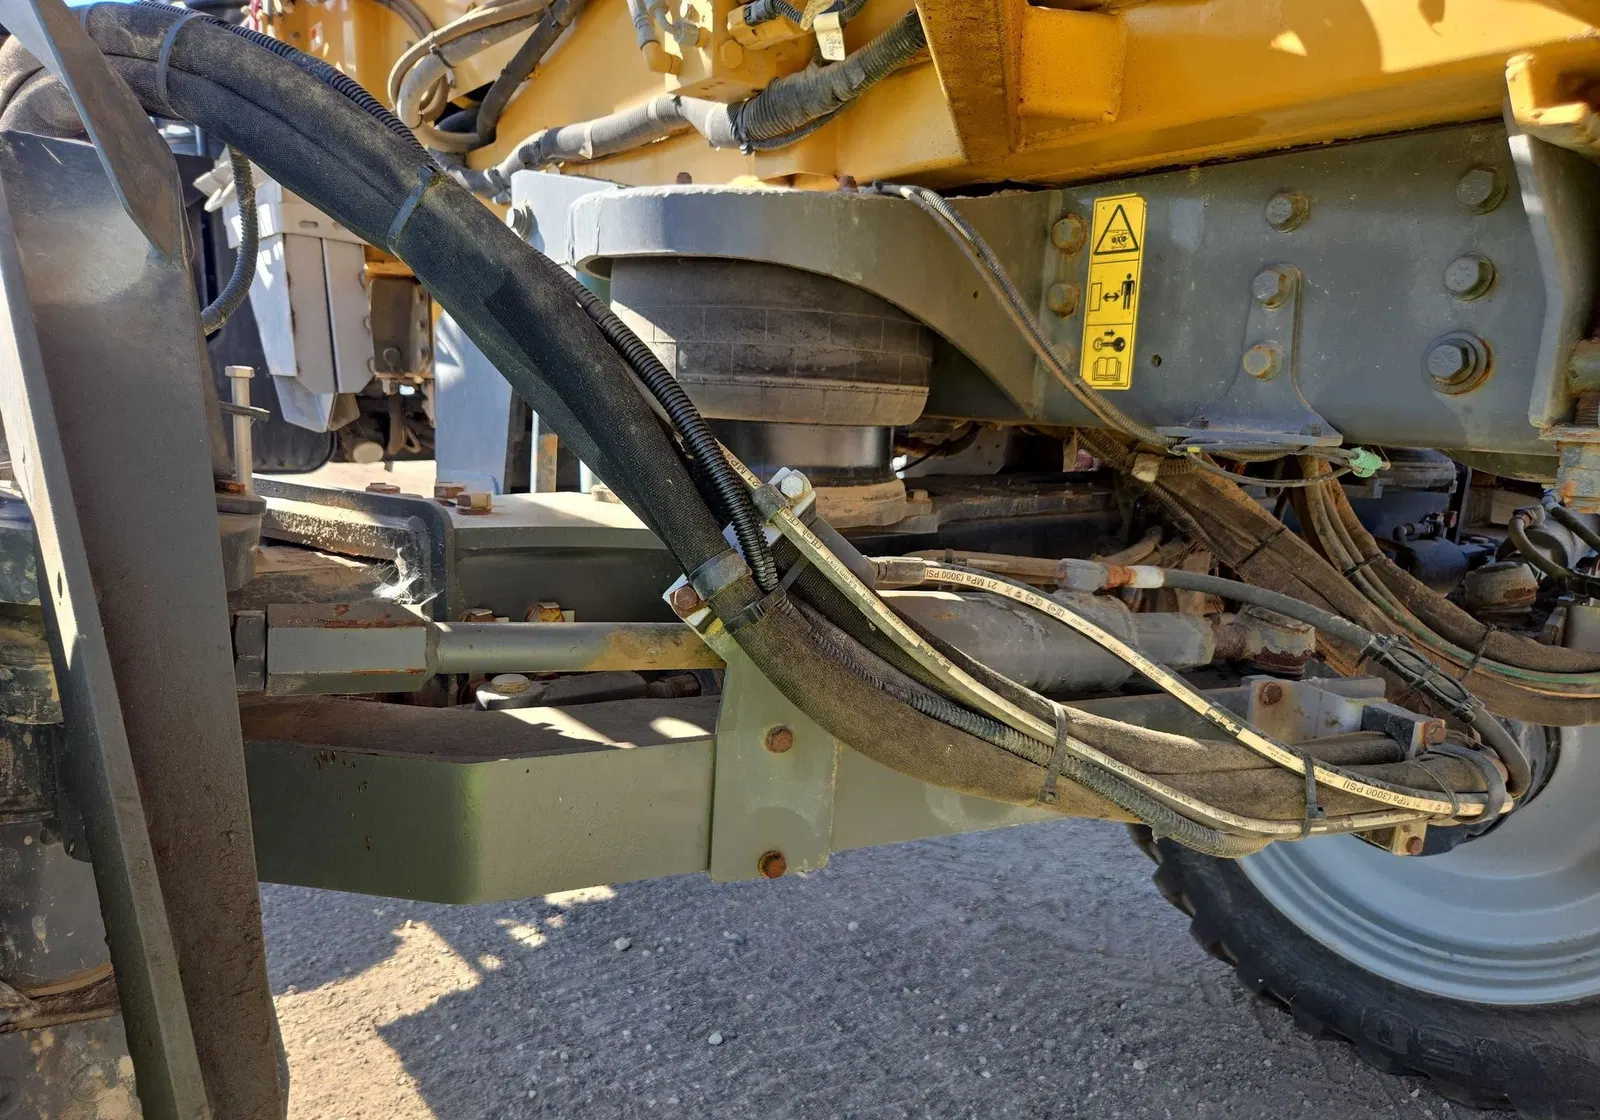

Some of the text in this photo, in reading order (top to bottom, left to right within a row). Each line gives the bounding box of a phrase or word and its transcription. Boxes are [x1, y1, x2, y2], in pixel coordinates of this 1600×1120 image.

[726, 453, 760, 487] 21 MPa
[839, 570, 850, 581] mm
[941, 571, 965, 582] (3000
[966, 575, 985, 587] MPa
[987, 580, 998, 590] 21
[1205, 708, 1236, 732] Parker
[1102, 756, 1126, 772] PSI)
[1155, 782, 1180, 799] MPa
[1342, 779, 1365, 794] PSI)
[1181, 795, 1193, 805] 21
[1366, 787, 1392, 802] (3000
